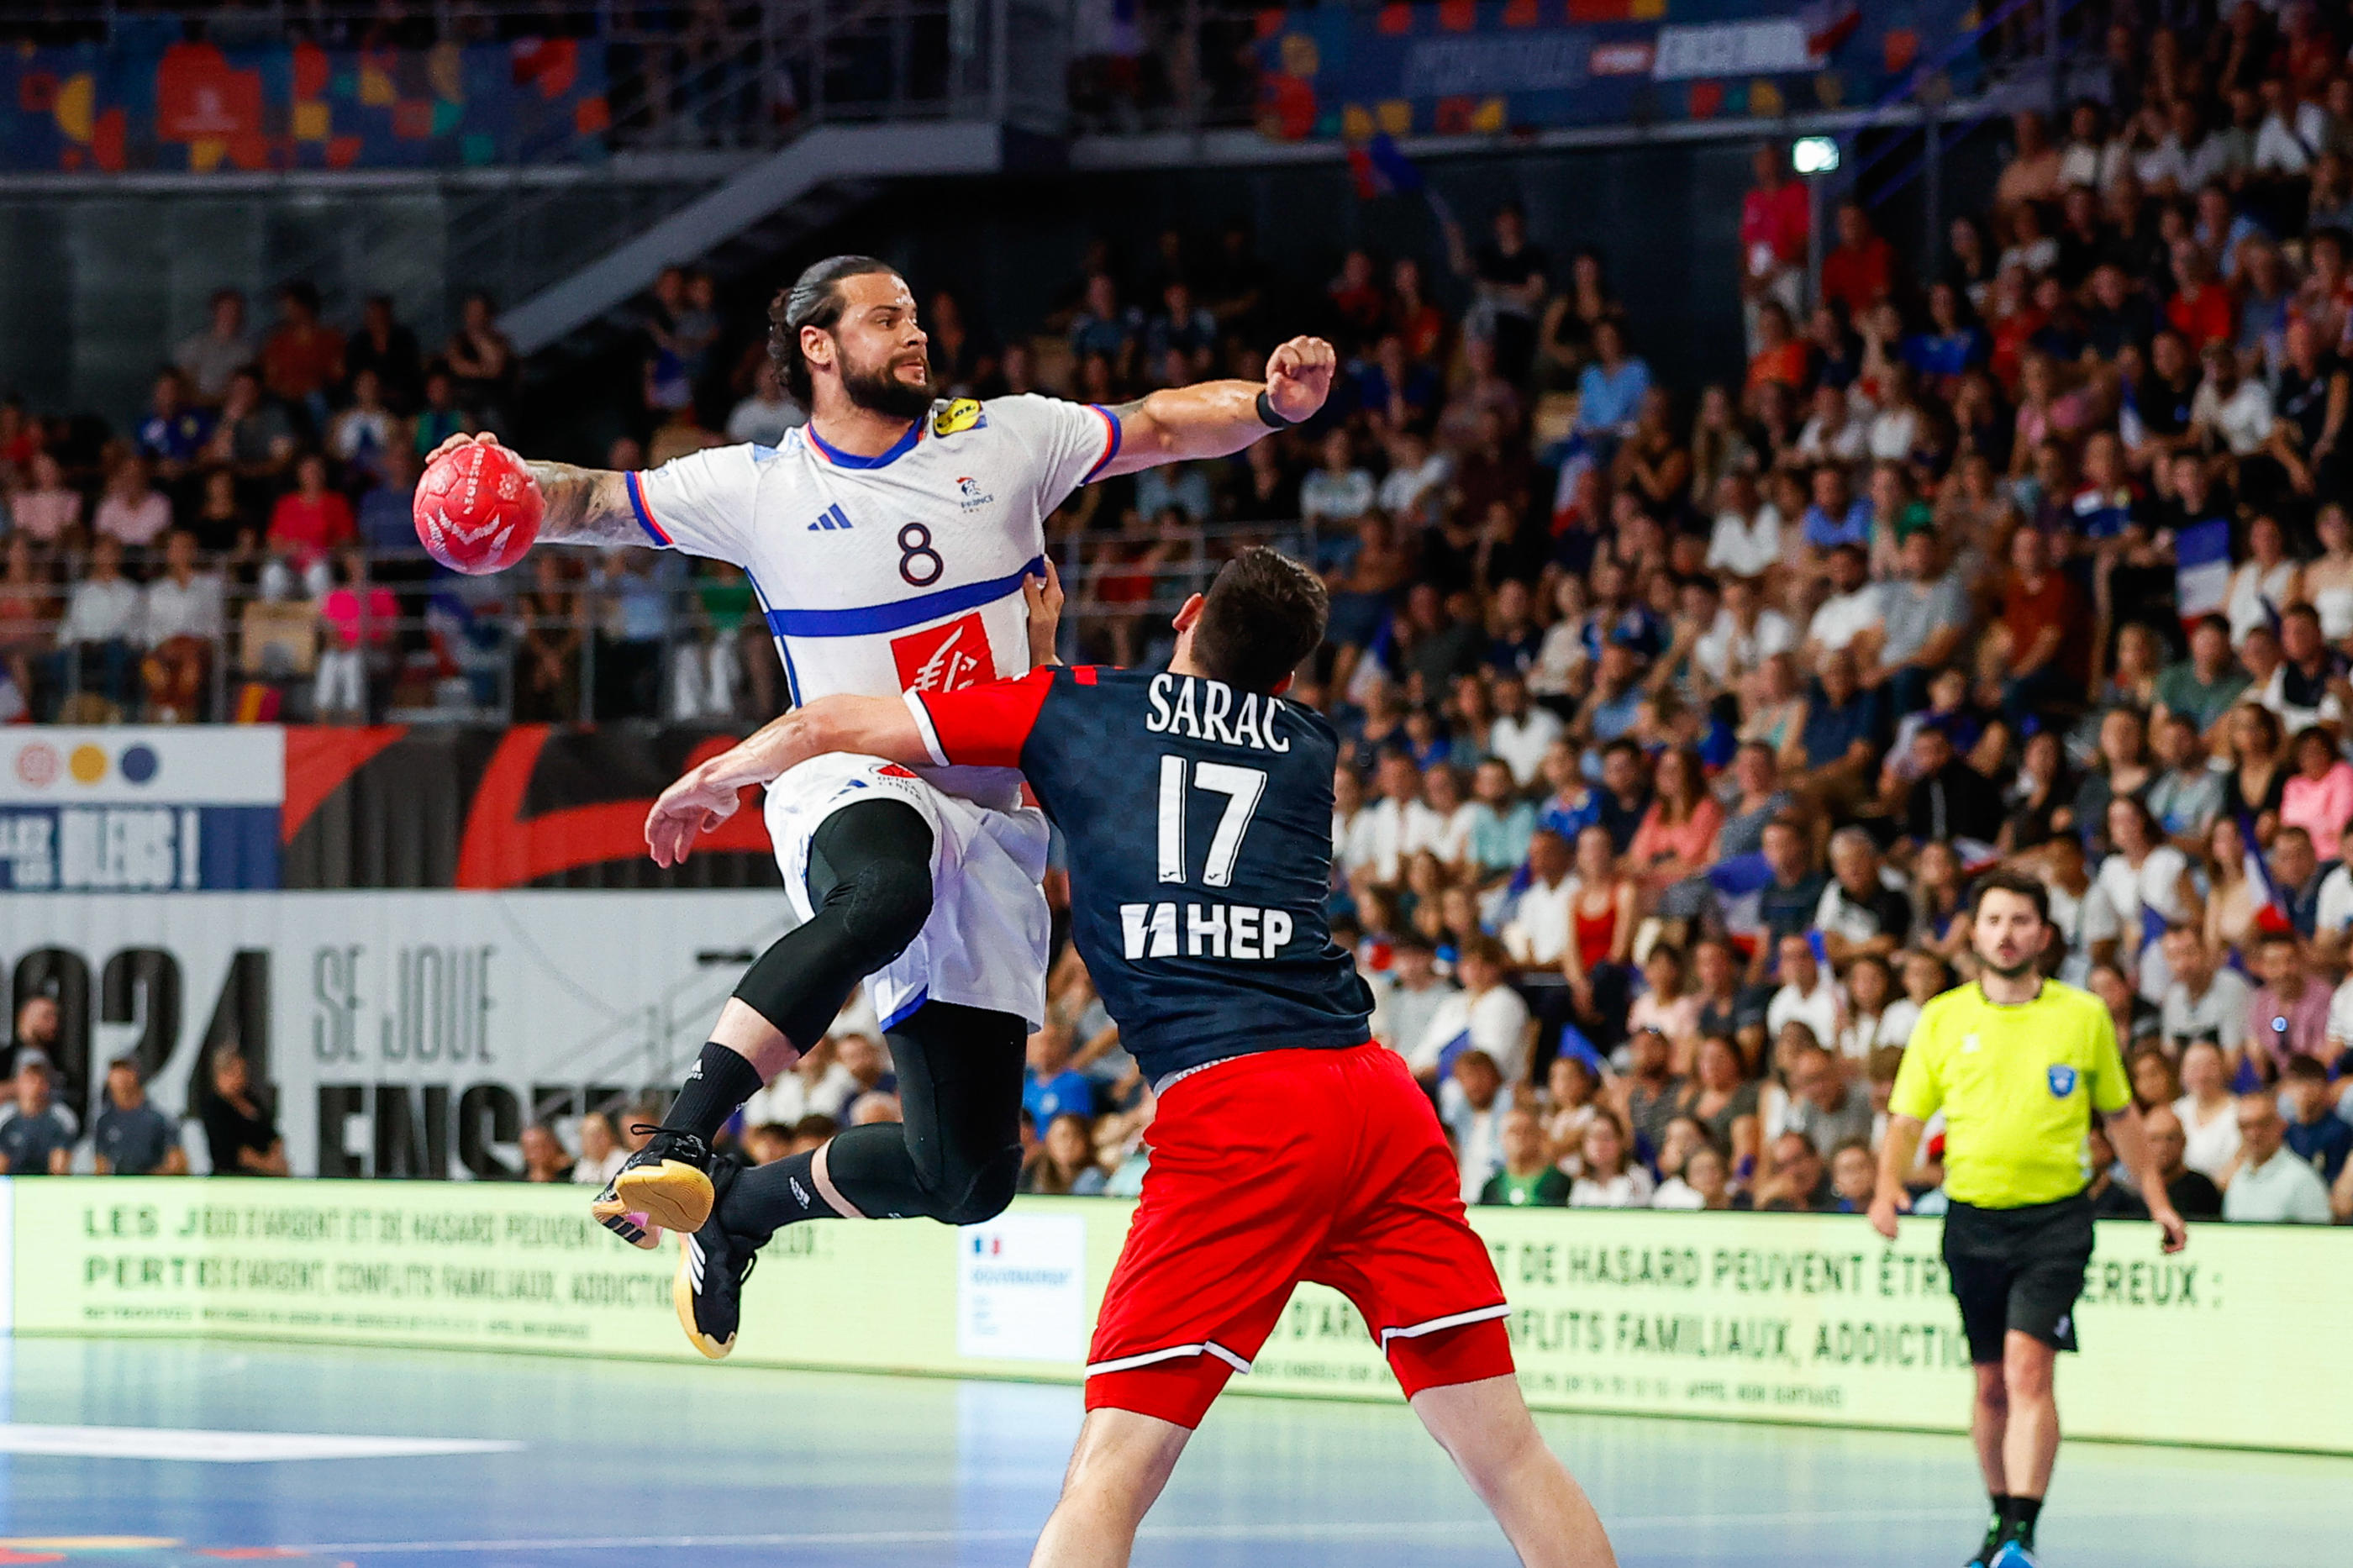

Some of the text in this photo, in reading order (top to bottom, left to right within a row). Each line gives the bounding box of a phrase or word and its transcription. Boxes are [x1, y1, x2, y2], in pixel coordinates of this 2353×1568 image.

[897, 522, 944, 587] 8
[1145, 671, 1291, 754] SARAC
[1157, 754, 1268, 888] 17
[1187, 902, 1293, 960] HEP
[313, 945, 363, 1061] SE
[381, 945, 494, 1062] JOUE
[1519, 1241, 1556, 1285] DE
[1568, 1244, 1701, 1289] HASARD
[1711, 1248, 1864, 1295] PEUVENT
[1877, 1245, 1950, 1298] ÊTR
[2082, 1260, 2199, 1308] EREUX
